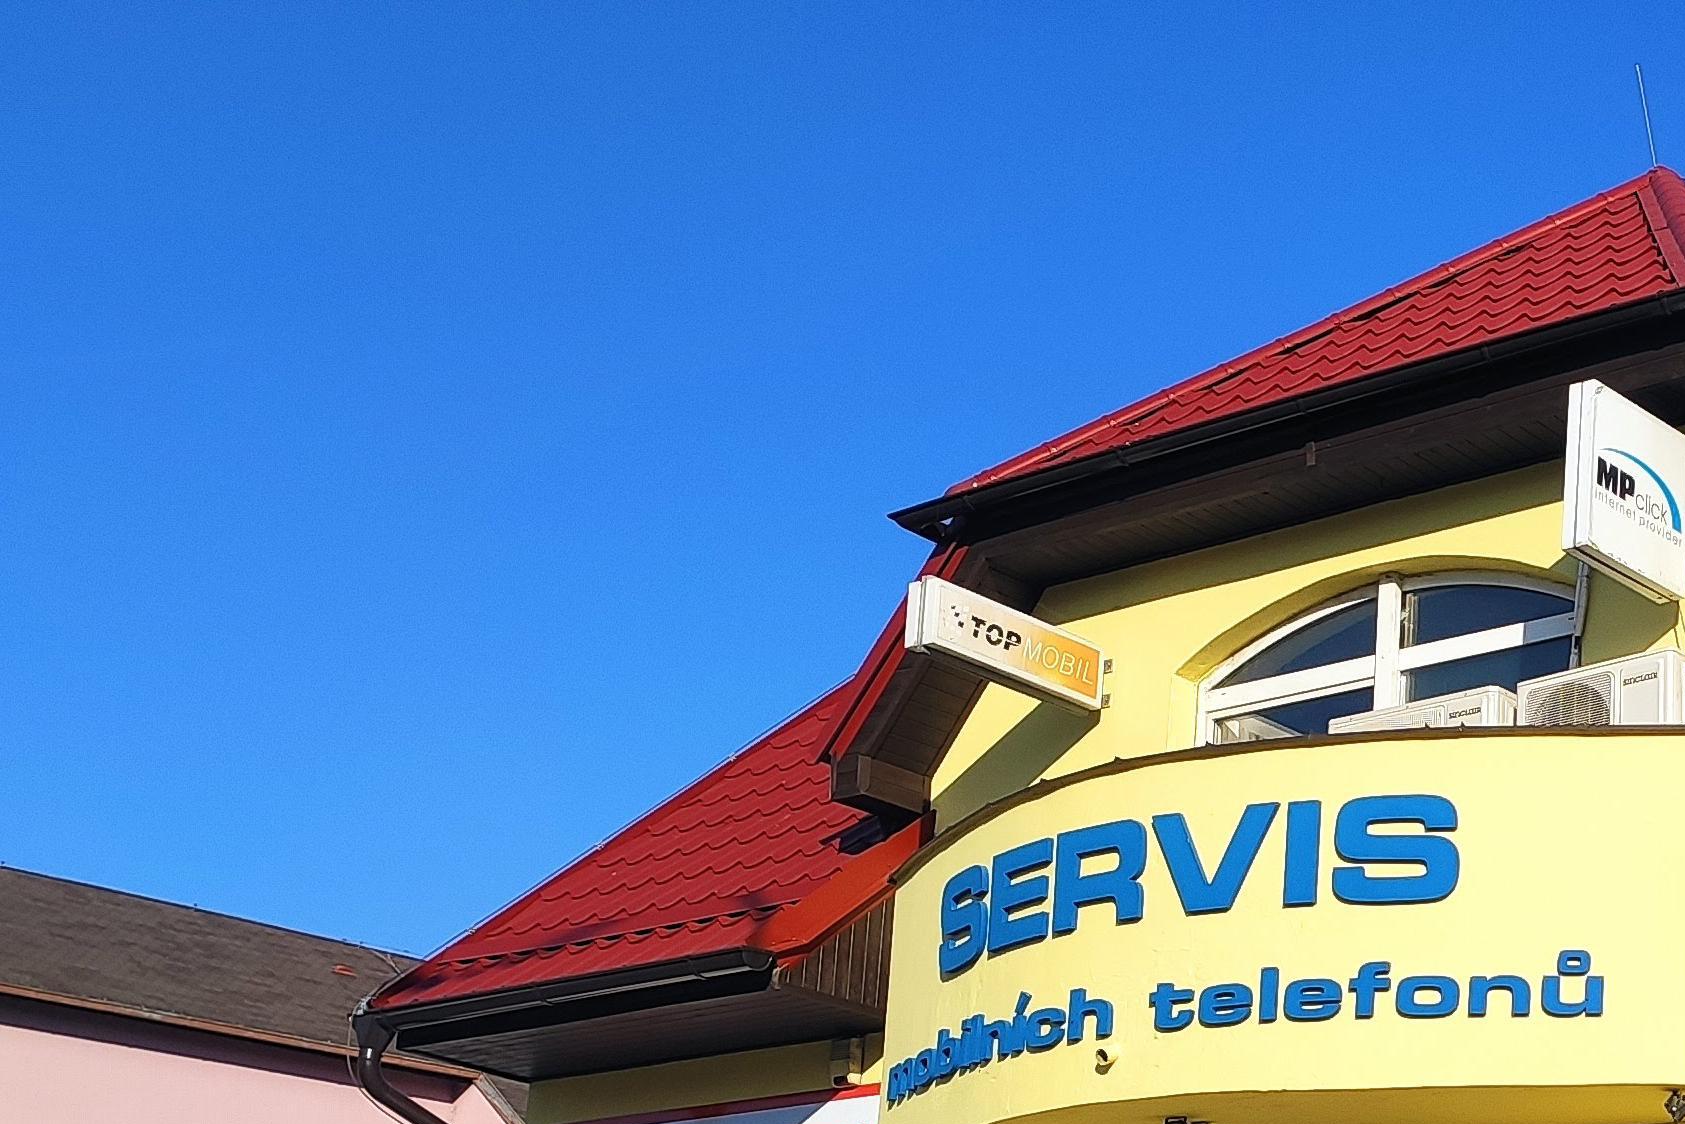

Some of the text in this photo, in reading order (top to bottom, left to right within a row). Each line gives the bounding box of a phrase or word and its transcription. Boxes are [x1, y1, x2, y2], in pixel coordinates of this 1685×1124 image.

[1595, 487, 1682, 547] internet provider
[938, 794, 1461, 981] SERVIS
[887, 949, 1604, 1109] mobilních telefonů
